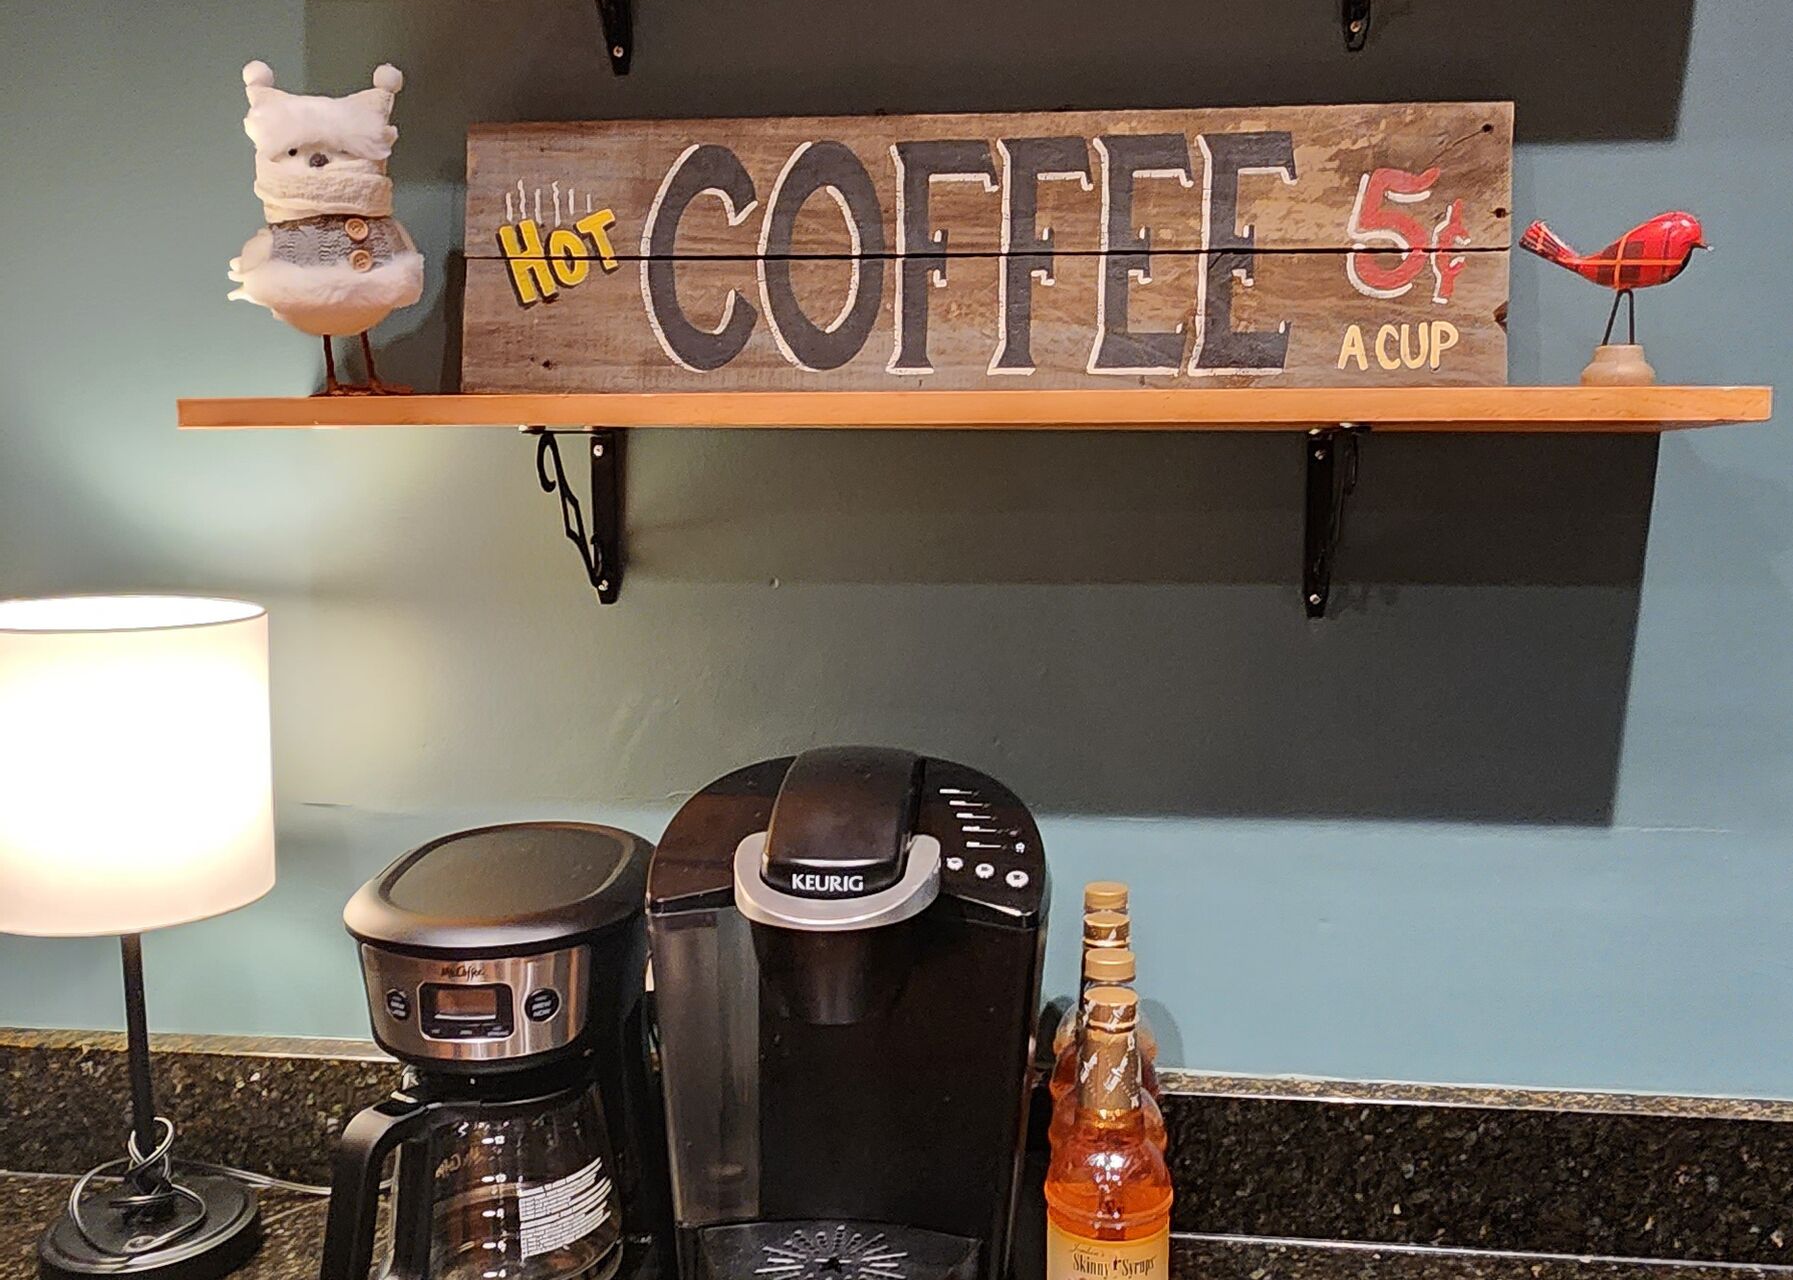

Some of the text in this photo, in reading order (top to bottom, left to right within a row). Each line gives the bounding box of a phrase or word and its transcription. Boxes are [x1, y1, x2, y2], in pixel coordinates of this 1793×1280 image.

[497, 207, 621, 310] HOT
[640, 130, 1299, 376] COFFEE
[1337, 320, 1460, 373] A CUP
[791, 872, 865, 894] KEURIG
[1073, 1252, 1156, 1280] Skinny Syrups
